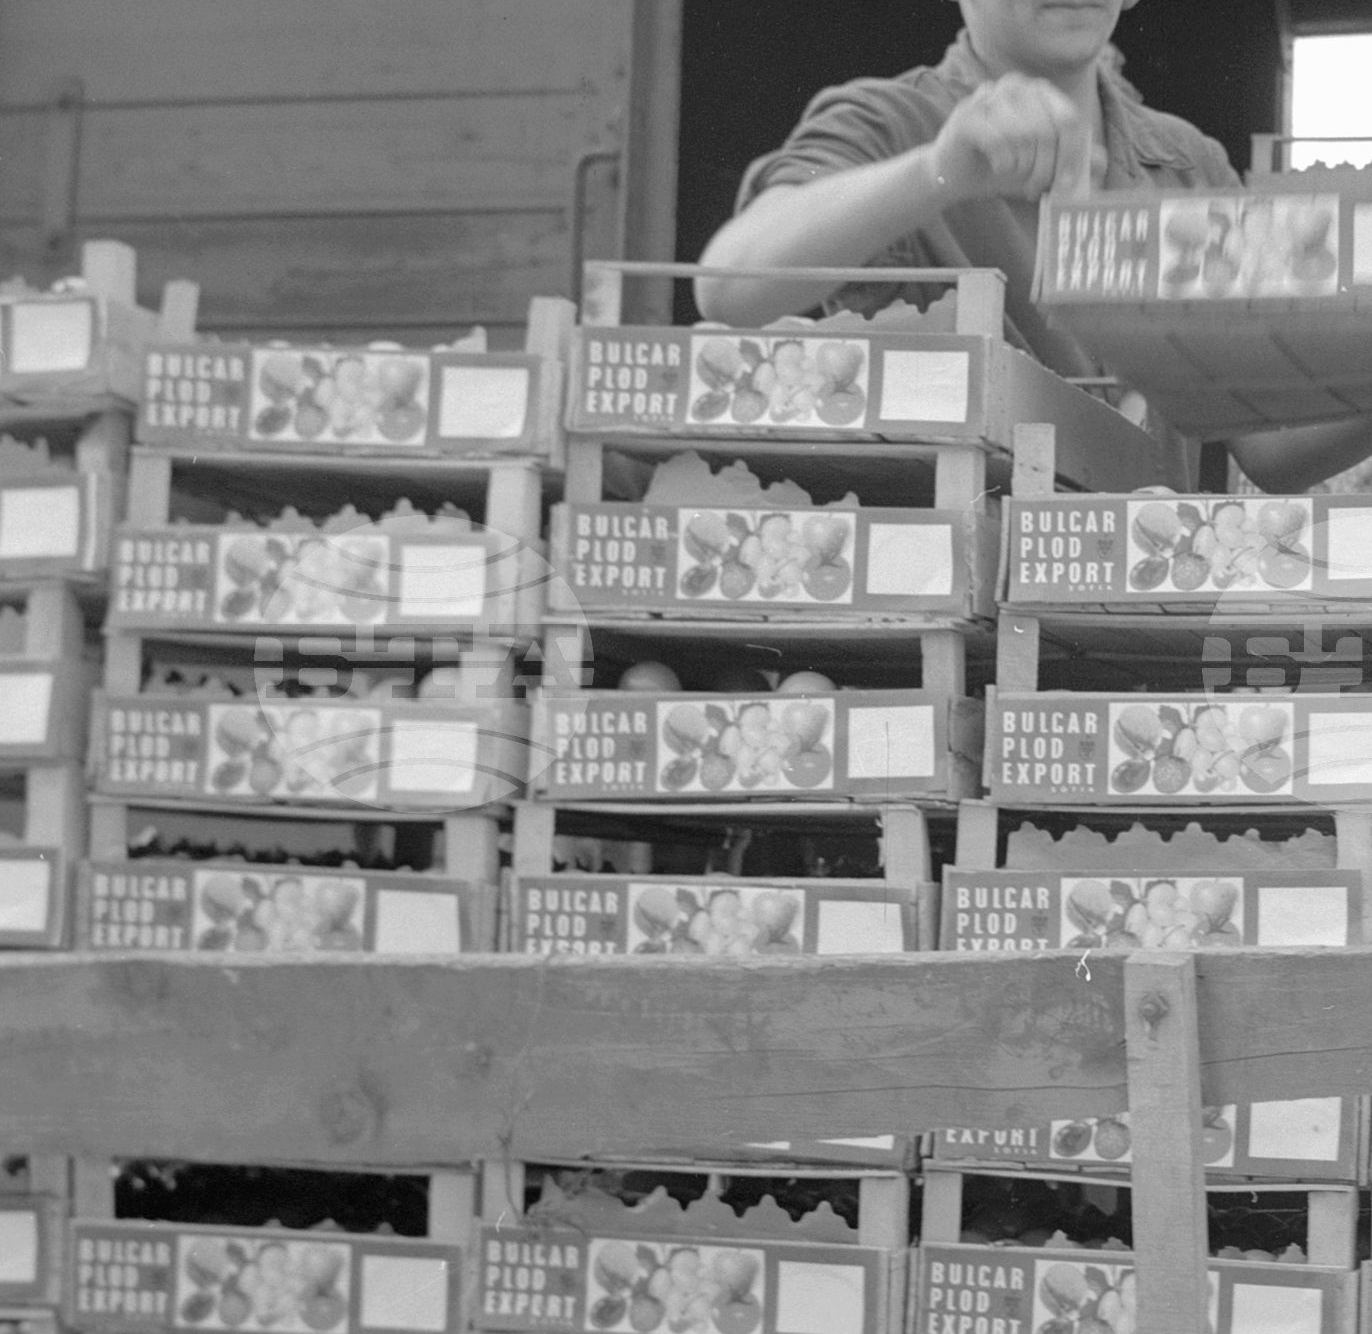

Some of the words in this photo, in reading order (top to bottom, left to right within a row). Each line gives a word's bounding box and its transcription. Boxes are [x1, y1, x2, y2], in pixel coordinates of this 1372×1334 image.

[588, 367, 648, 389] PLOD
[586, 393, 678, 415] EXPORT
[576, 540, 636, 562] PLOD
[1020, 536, 1082, 558] PLOD
[574, 565, 666, 588] EXPORT
[1020, 562, 1115, 584] EXPORT
[556, 738, 615, 759] PLOD
[1002, 737, 1064, 760] PLOD
[556, 762, 646, 784] EXPORT
[1002, 762, 1096, 785] EXPORT
[528, 915, 586, 936] PLOD
[957, 912, 1018, 935] PLOD
[487, 1267, 546, 1290] PLOD
[930, 1288, 991, 1313] PLOD
